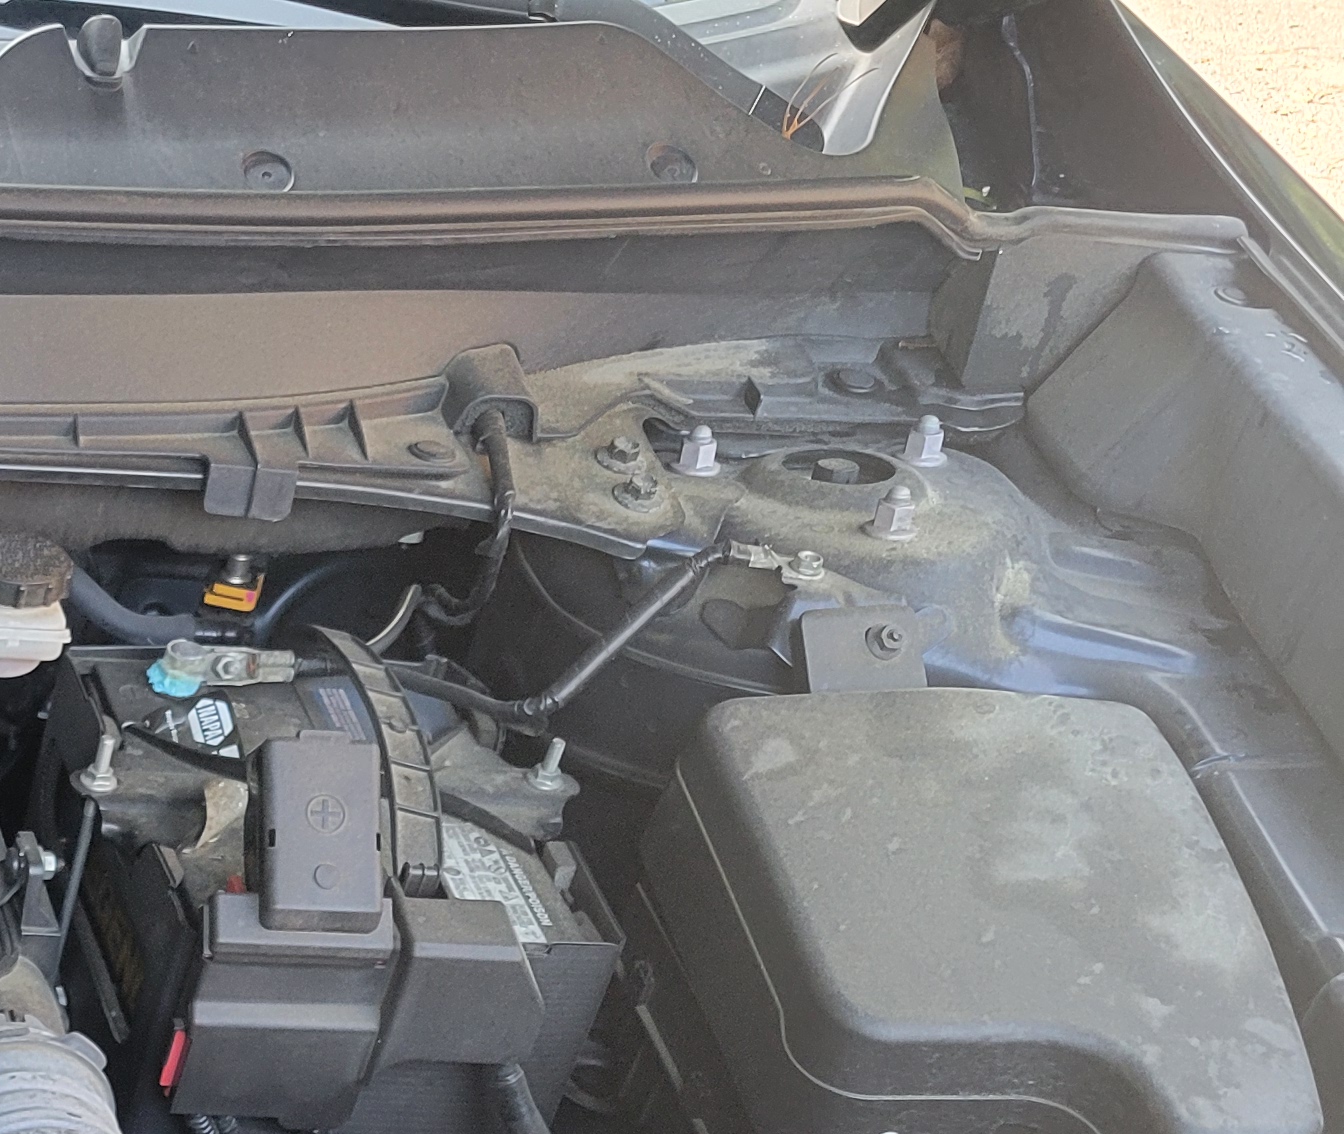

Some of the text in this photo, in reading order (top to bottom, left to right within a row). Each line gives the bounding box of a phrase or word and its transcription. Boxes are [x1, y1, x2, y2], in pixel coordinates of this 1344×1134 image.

[197, 705, 223, 740] NAPA
[505, 854, 553, 926] DANGER POISON
